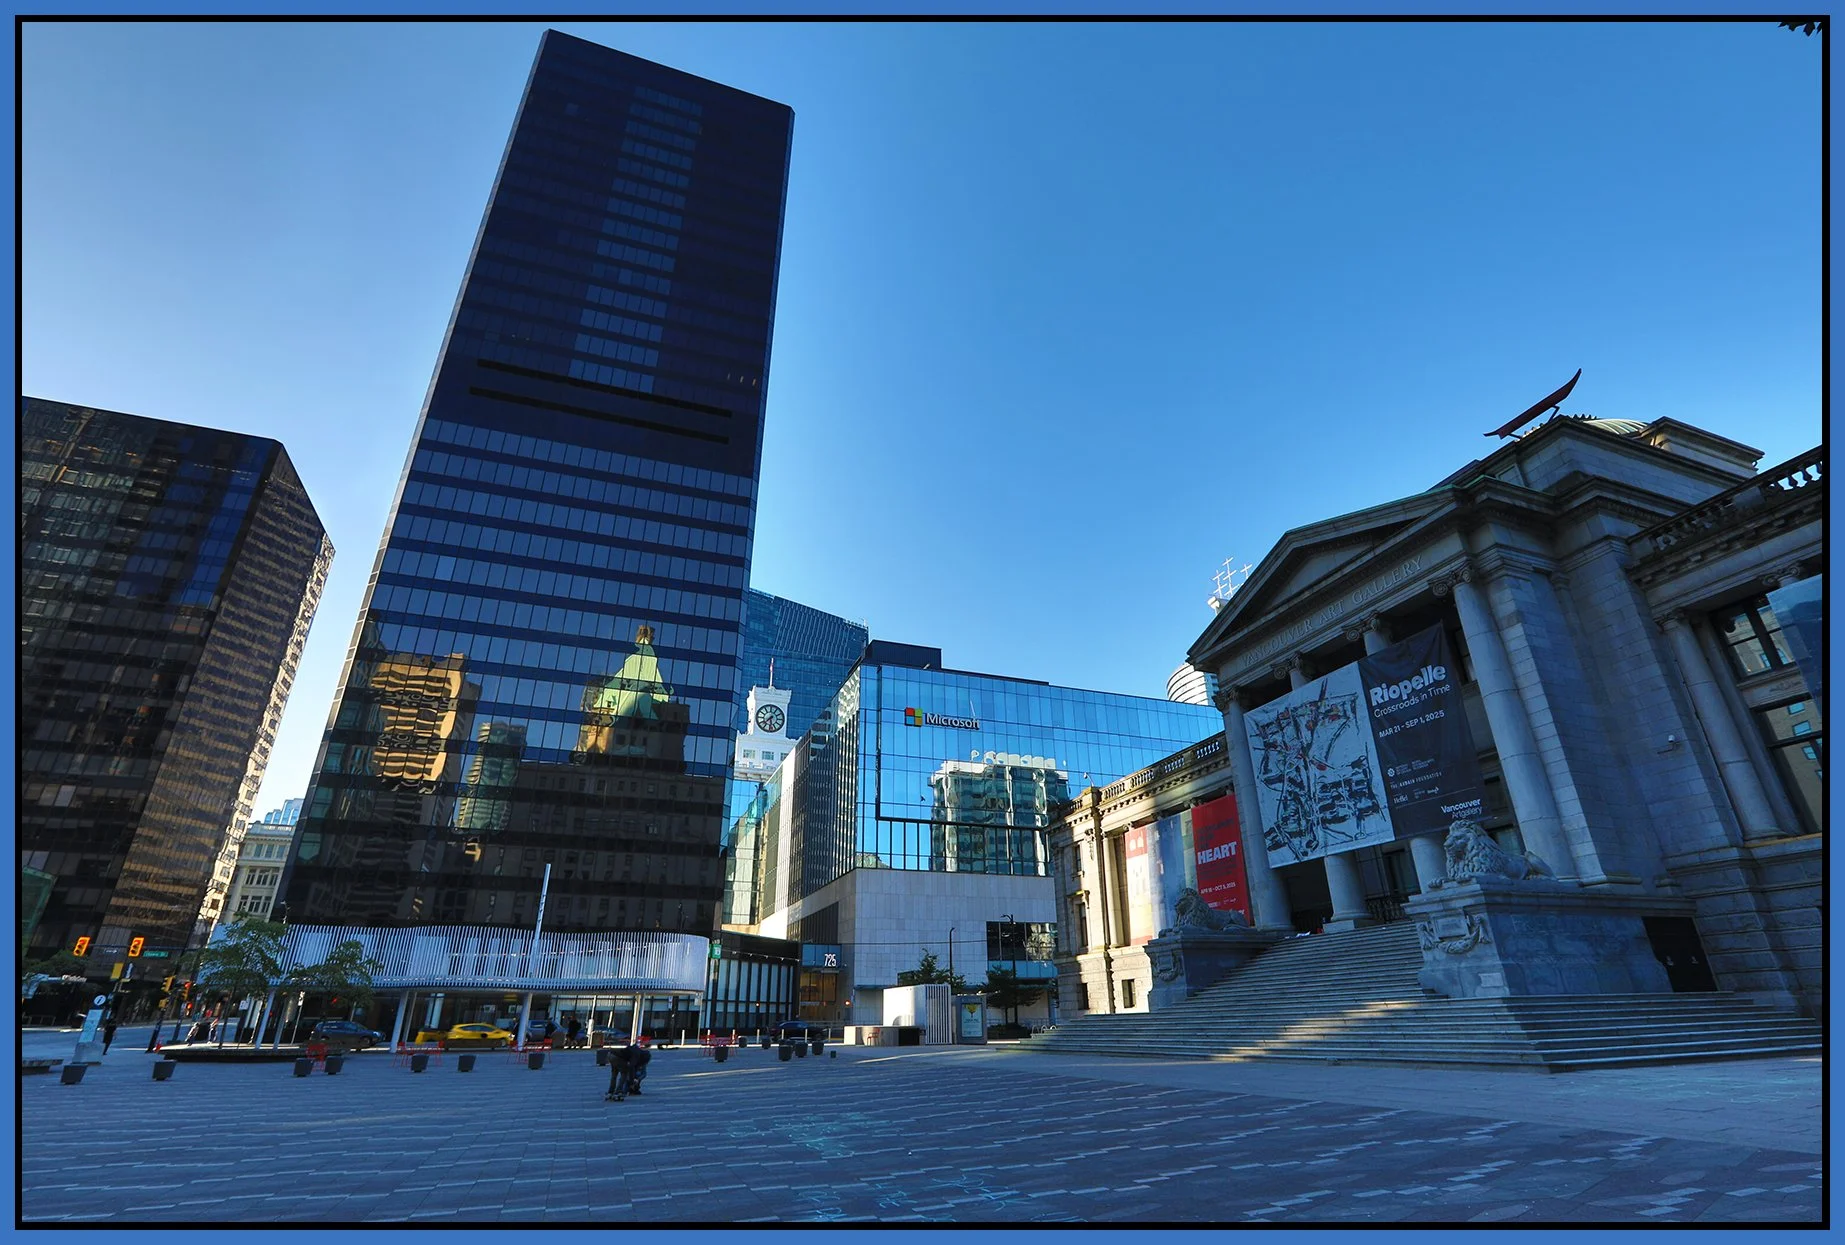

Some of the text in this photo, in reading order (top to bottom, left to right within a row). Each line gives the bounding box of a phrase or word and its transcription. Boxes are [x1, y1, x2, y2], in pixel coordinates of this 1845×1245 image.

[1242, 554, 1423, 667] VANCOUVER ART GALLERY
[1369, 665, 1446, 706] Riopelle
[1374, 684, 1451, 718] Crossroads in Time
[926, 712, 980, 728] Microsoft
[1379, 727, 1394, 738] MAR
[1393, 725, 1401, 733] 21
[1405, 718, 1419, 729] SEP
[1426, 710, 1445, 722] 2025
[1441, 799, 1481, 814] Vancouver
[1197, 841, 1238, 865] HEART
[824, 953, 837, 967] 725
